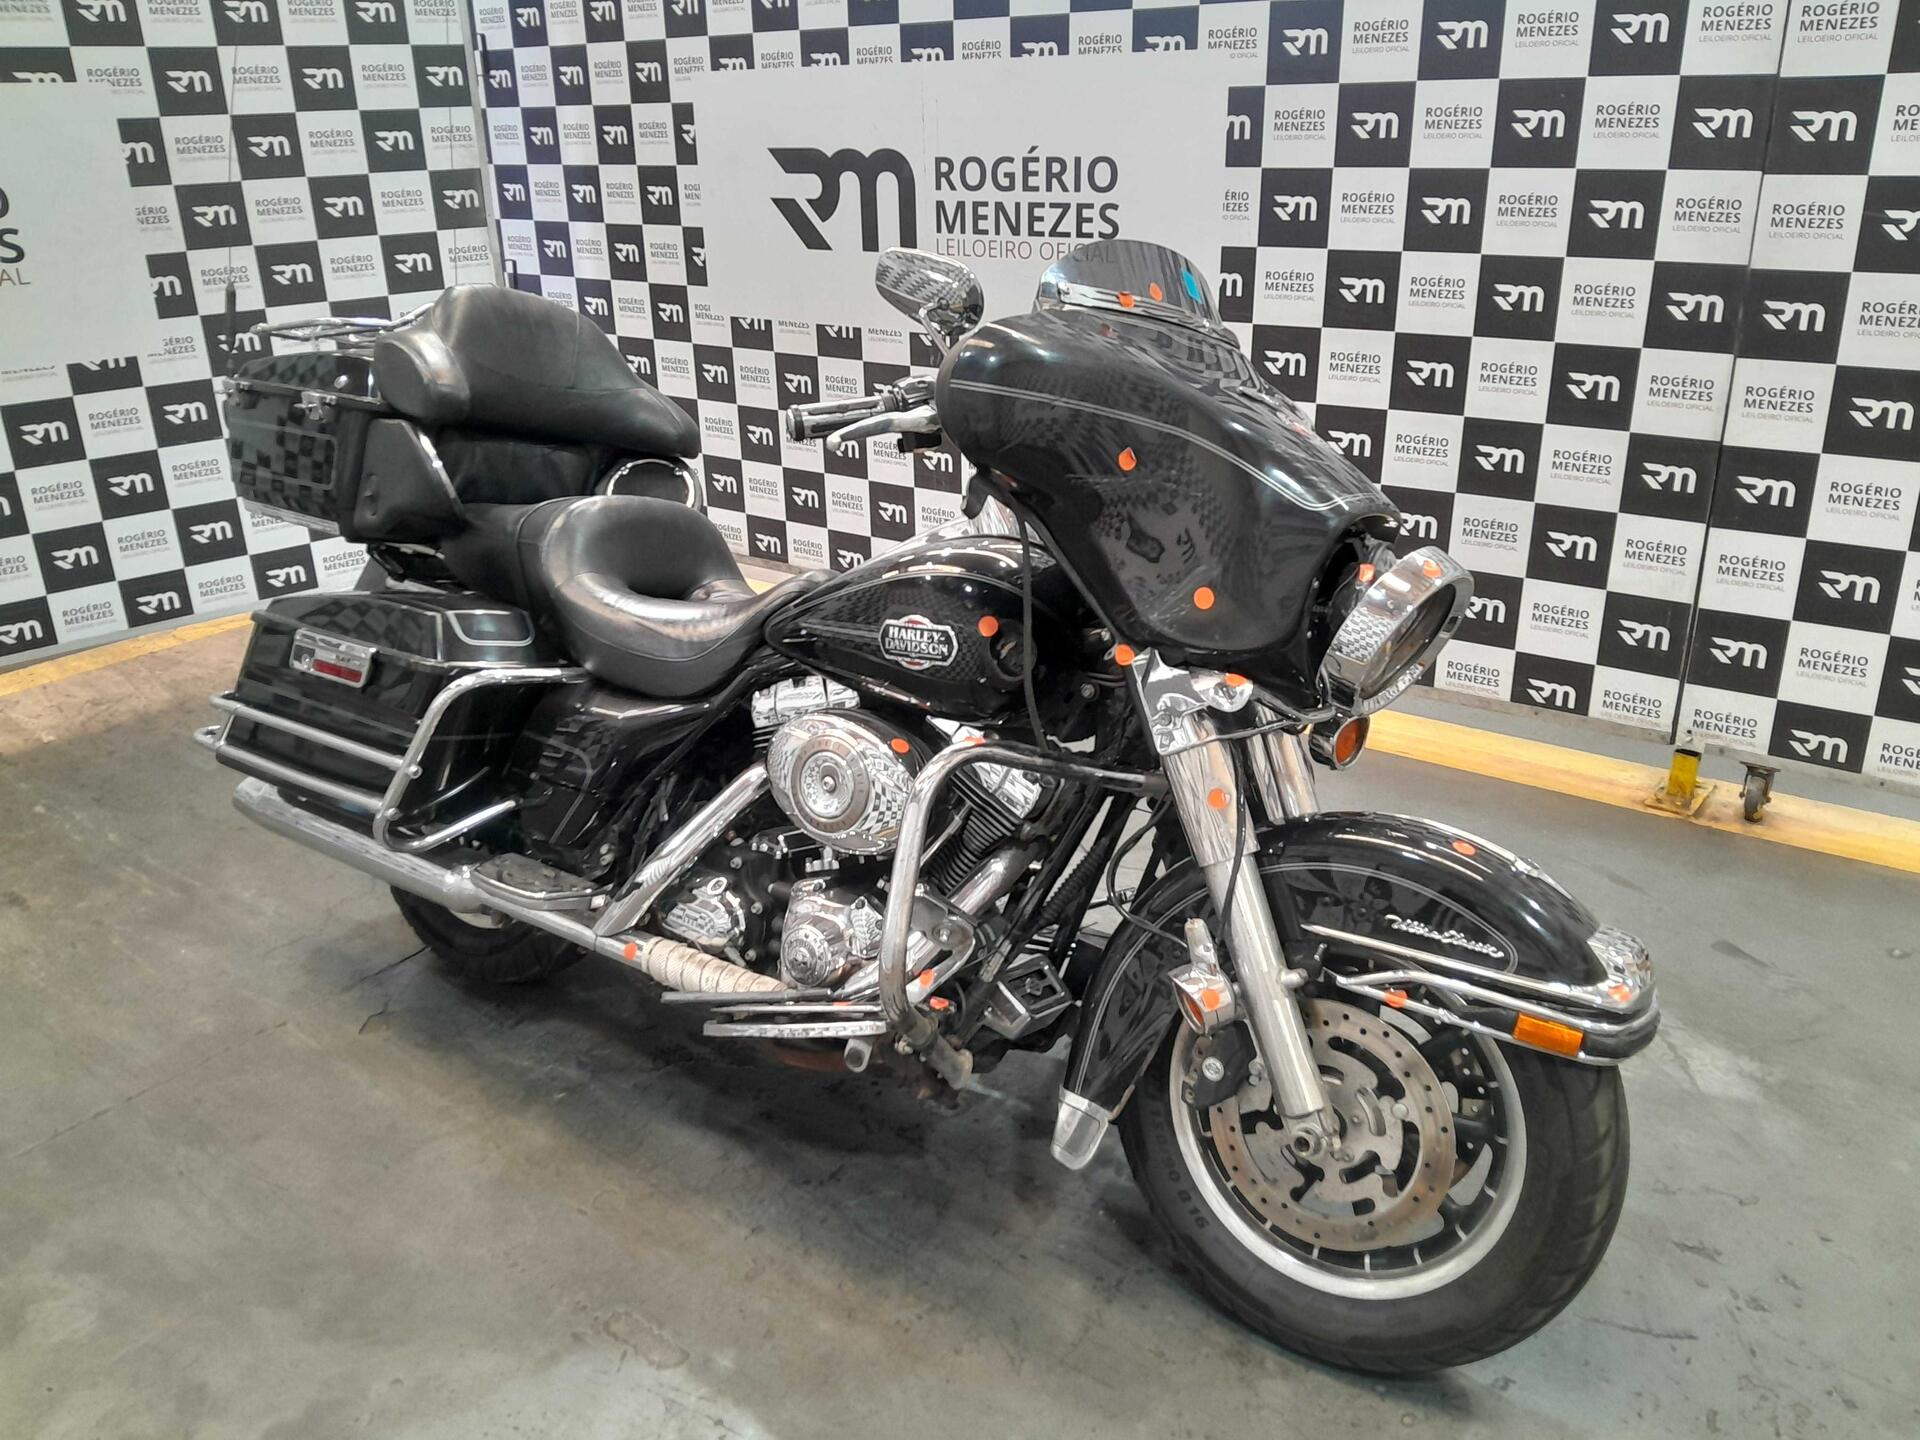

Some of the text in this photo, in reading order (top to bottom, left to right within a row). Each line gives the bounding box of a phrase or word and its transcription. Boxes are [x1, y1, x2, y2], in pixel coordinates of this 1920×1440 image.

[1703, 2, 1773, 18] ROGÉRIO
[1802, 0, 1880, 17] ROGÉRIO
[1518, 10, 1579, 25] ROGÉRIO
[1799, 16, 1878, 32] MENEZES
[1354, 18, 1409, 32] ROGÉRIO
[1516, 25, 1578, 38] MENEZES
[1701, 18, 1772, 32] MENEZES
[1353, 32, 1408, 44] MENEZES
[1515, 40, 1551, 48] LEILOEIRO
[1699, 34, 1772, 43] LEILOEIRO OFICIAL
[1797, 33, 1878, 44] LEILOEIRO OFICIAL
[86, 66, 140, 77] ROGÉRIO
[231, 64, 279, 75] ROGÉRIO
[361, 62, 404, 72] ROGÉRIO
[233, 76, 281, 84] MENEZES
[362, 73, 407, 81] MENEZES
[1275, 107, 1325, 120] ROGÉRIO
[1426, 104, 1483, 117] ROGÉRIO
[1596, 101, 1661, 115] ROGÉRIO
[430, 124, 471, 134] ROGÉRIO
[1274, 121, 1325, 131] MENEZES
[1425, 119, 1482, 130] MENEZES
[1595, 118, 1660, 128] MENEZES
[175, 134, 223, 145] ROGÉRIO
[308, 128, 353, 139] ROGÉRIO
[432, 134, 473, 142] MENEZES
[176, 145, 226, 154] MENEZES
[310, 139, 355, 148] MENEZES
[934, 145, 1119, 193] ROGÉRIO
[380, 188, 422, 199] ROGÉRIO
[1342, 190, 1395, 203] ROGÉRIO
[1499, 192, 1558, 206] ROGÉRIO
[255, 196, 301, 207] ROGÉRIO
[382, 198, 424, 207] MENEZES
[1676, 196, 1742, 210] ROGÉRIO
[1772, 201, 1845, 216] ROGÉRIO
[256, 206, 303, 216] MENEZES
[1341, 204, 1394, 214] MENEZES
[1498, 207, 1557, 218] MENEZES
[936, 200, 1120, 239] MENEZES
[1674, 211, 1741, 223] MENEZES
[1770, 217, 1844, 229] MENEZES
[1712, 226, 1741, 234] OFICIAL
[448, 244, 487, 255] ROGÉRIO
[936, 238, 1115, 264] LEILOEIRO OFICIAL
[330, 254, 373, 265] ROGÉRIO
[449, 253, 489, 263] MENEZES
[201, 266, 247, 277] ROGÉRIO
[331, 263, 375, 274] MENEZES
[1266, 269, 1314, 282] ROGÉRIO
[1265, 282, 1314, 292] MENEZES
[1411, 275, 1466, 288] ROGÉRIO
[1410, 288, 1465, 300] MENEZES
[1574, 283, 1636, 297] ROGÉRIO
[1573, 296, 1635, 309] MENEZES
[1330, 351, 1381, 364] ROGÉRIO
[1329, 363, 1380, 374] MENEZES
[1481, 362, 1538, 375] ROGÉRIO
[1480, 374, 1537, 387] MENEZES
[1650, 375, 1714, 390] ROGÉRIO
[1649, 387, 1713, 402] MENEZES
[1745, 386, 1815, 401] ROGÉRIO
[1744, 398, 1814, 413] MENEZES
[88, 407, 138, 421] ROGÉRIO
[90, 416, 141, 430] MENEZES
[1396, 434, 1449, 447] ROGÉRIO
[1395, 444, 1448, 458] MENEZES
[1553, 450, 1612, 464] ROGÉRIO
[172, 458, 219, 472] ROGÉRIO
[1552, 461, 1611, 476] MENEZES
[174, 467, 222, 481] MENEZES
[31, 480, 82, 496] ROGÉRIO
[1830, 482, 1902, 498] ROGÉRIO
[33, 489, 86, 504] MENEZES
[1828, 494, 1900, 511] MENEZES
[1464, 517, 1518, 532] ROGÉRIO
[117, 529, 165, 544] ROGÉRIO
[1462, 528, 1518, 543] MENEZES
[119, 537, 168, 552] MENEZES
[1626, 539, 1687, 555] ROGÉRIO
[322, 551, 362, 565] ROGÉRIO
[324, 558, 365, 572] MENEZES
[1625, 550, 1686, 567] MENEZES
[1719, 554, 1786, 571] ROGÉRIO
[1718, 566, 1785, 582] MENEZES
[198, 574, 243, 590] ROGÉRIO
[200, 582, 246, 597] MENEZES
[62, 601, 111, 618] ROGÉRIO
[1533, 603, 1590, 619] ROGÉRIO
[64, 609, 114, 626] MENEZES
[1532, 613, 1589, 630] MENEZES
[888, 626, 946, 643] HARLEY-
[885, 637, 948, 656] DAVIDSON
[1800, 647, 1869, 666] ROGÉRIO
[1448, 661, 1500, 677] ROGÉRIO
[1798, 658, 1867, 678] MENEZES
[1447, 670, 1499, 688] MENEZES
[1604, 690, 1662, 708] ROGÉRIO
[1602, 700, 1661, 719] MENEZES
[1694, 709, 1758, 728] ROGÉRIO
[1692, 719, 1756, 739] MENEZES
